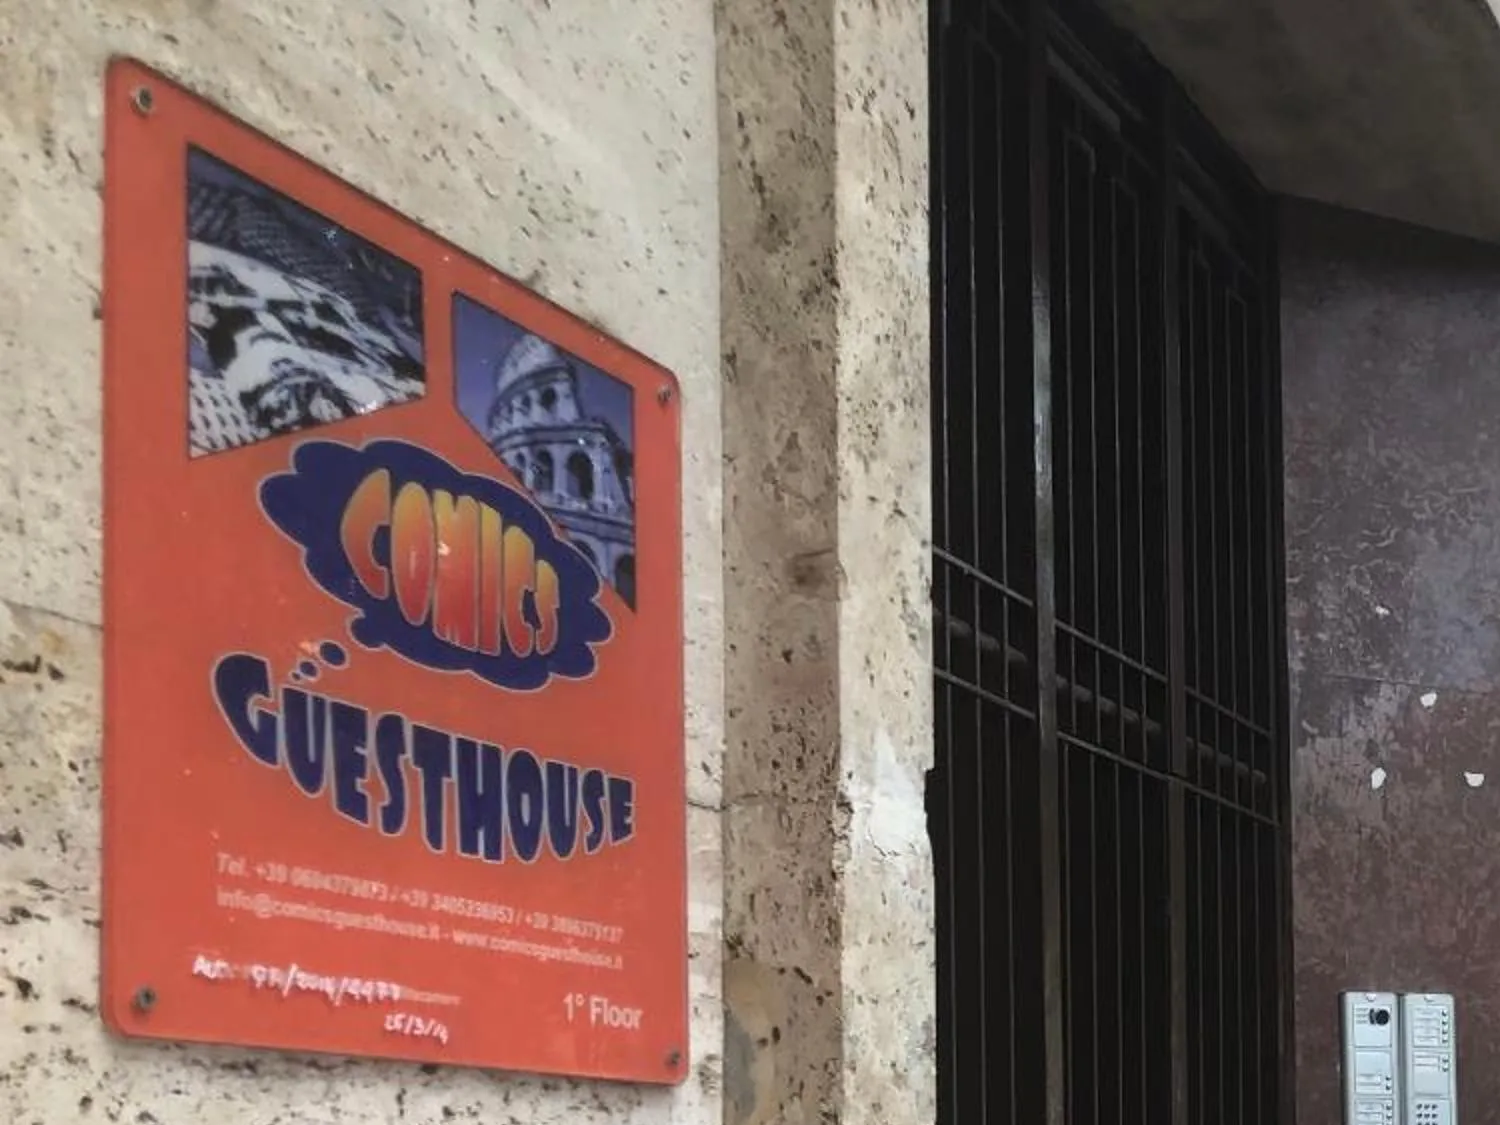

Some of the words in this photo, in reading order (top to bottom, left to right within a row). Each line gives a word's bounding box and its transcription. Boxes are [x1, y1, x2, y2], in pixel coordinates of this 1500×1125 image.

[339, 468, 559, 658] COMICS
[211, 651, 636, 864] GUESTHOUSE
[216, 851, 250, 877] Tel.
[254, 861, 288, 884] +39
[589, 994, 644, 1030] Floor
